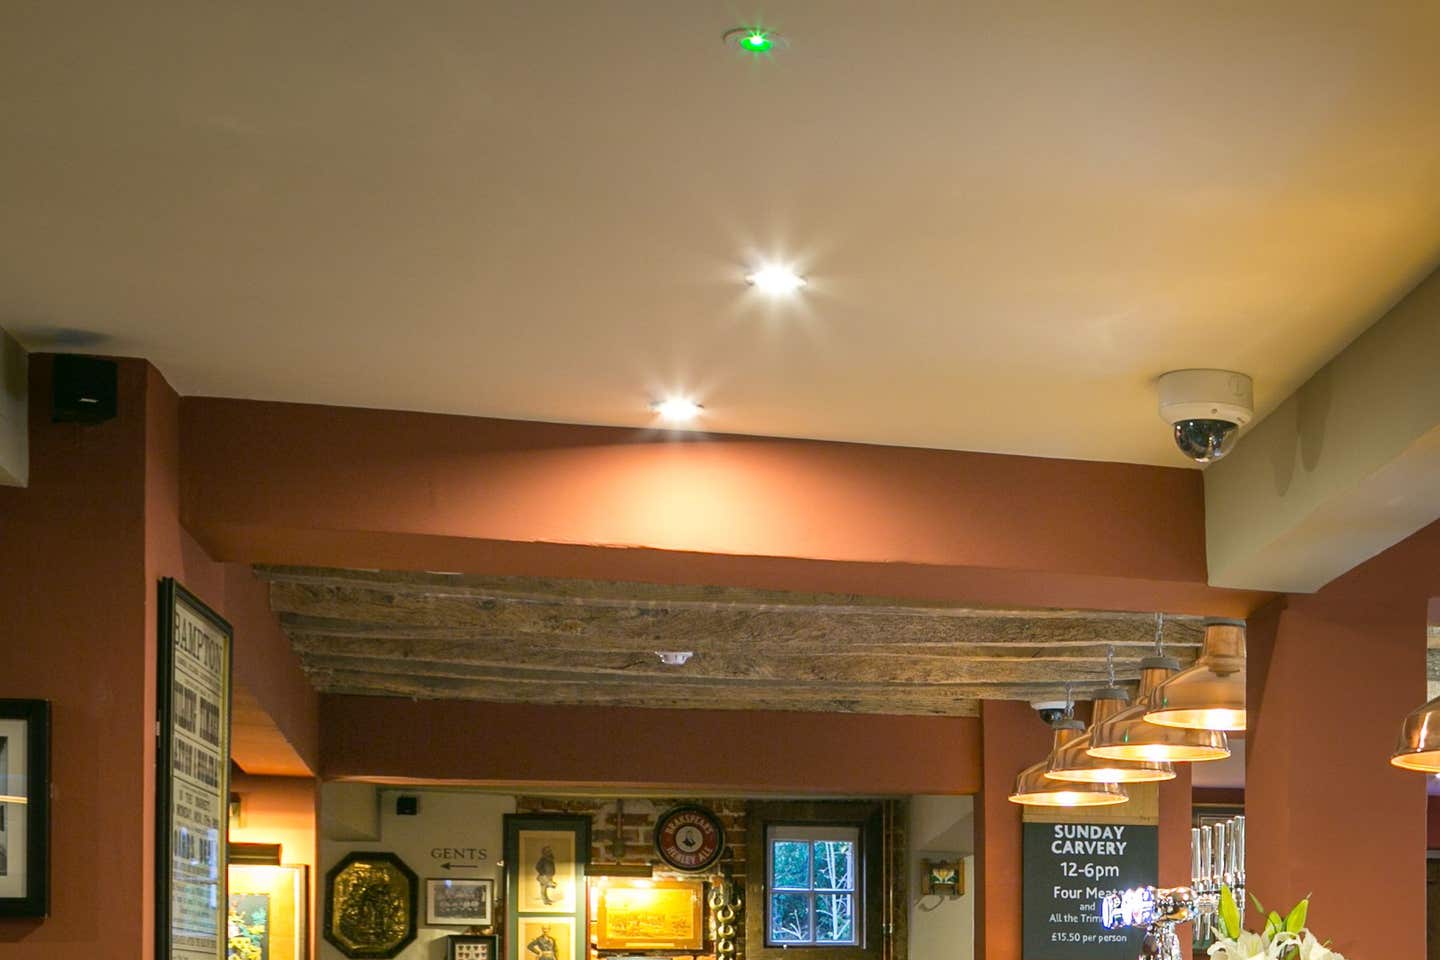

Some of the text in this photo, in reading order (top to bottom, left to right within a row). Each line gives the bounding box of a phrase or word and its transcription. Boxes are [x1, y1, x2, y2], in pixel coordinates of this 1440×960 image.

[1054, 825, 1125, 839] SUNDAY
[431, 847, 488, 860] GENTS
[1051, 841, 1127, 855] CARVERY
[1060, 862, 1120, 881] 12-6pm
[1053, 886, 1083, 899] Four
[1079, 902, 1096, 911] and
[1048, 913, 1063, 923] All
[1064, 914, 1079, 923] the
[1051, 932, 1127, 945] £15.50 per person
